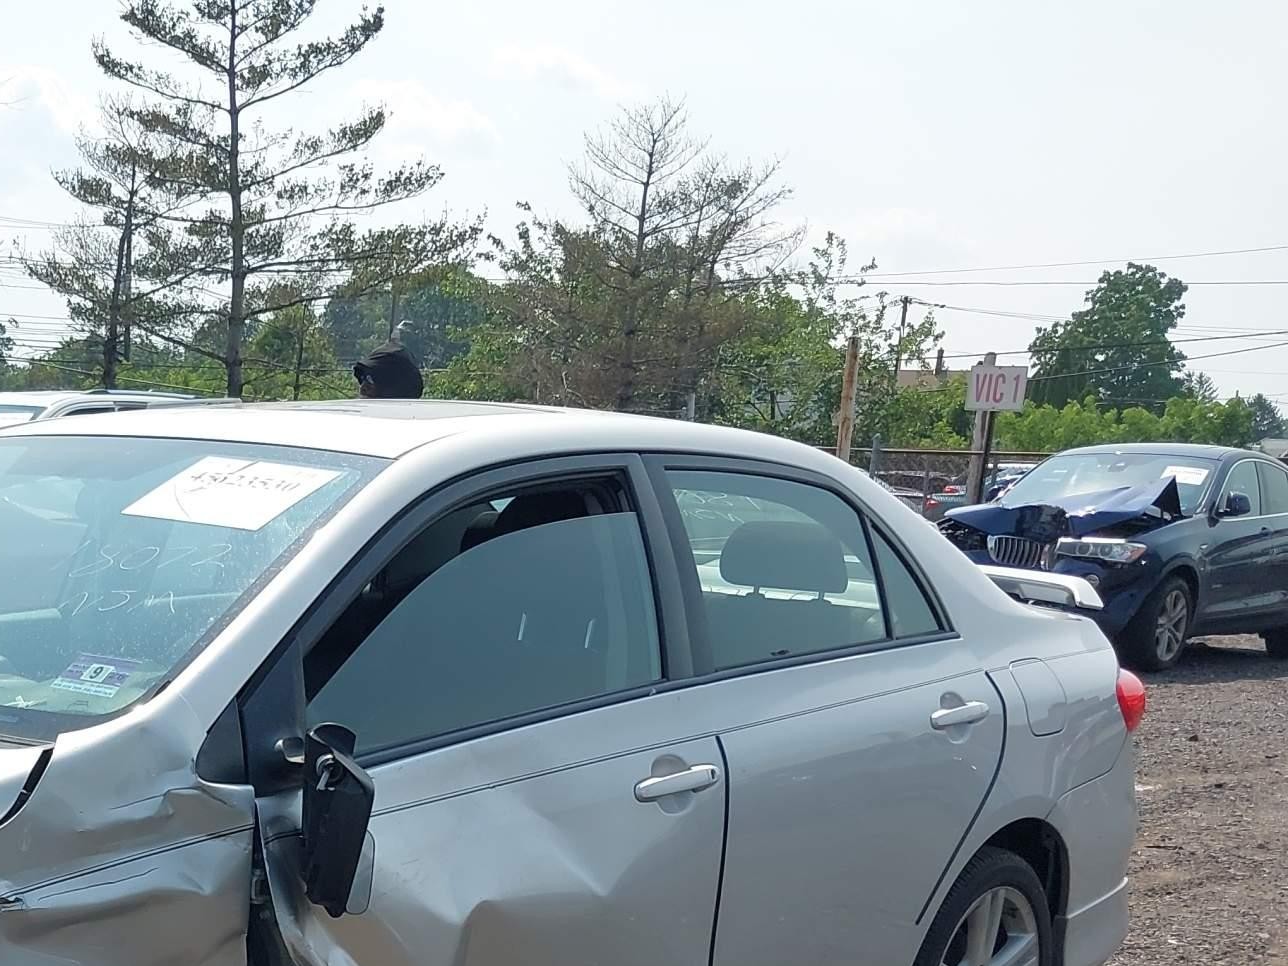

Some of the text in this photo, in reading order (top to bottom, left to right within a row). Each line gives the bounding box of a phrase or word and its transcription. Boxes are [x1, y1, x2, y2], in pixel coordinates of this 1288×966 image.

[975, 373, 1021, 403] VIC 1
[88, 665, 105, 680] 9
